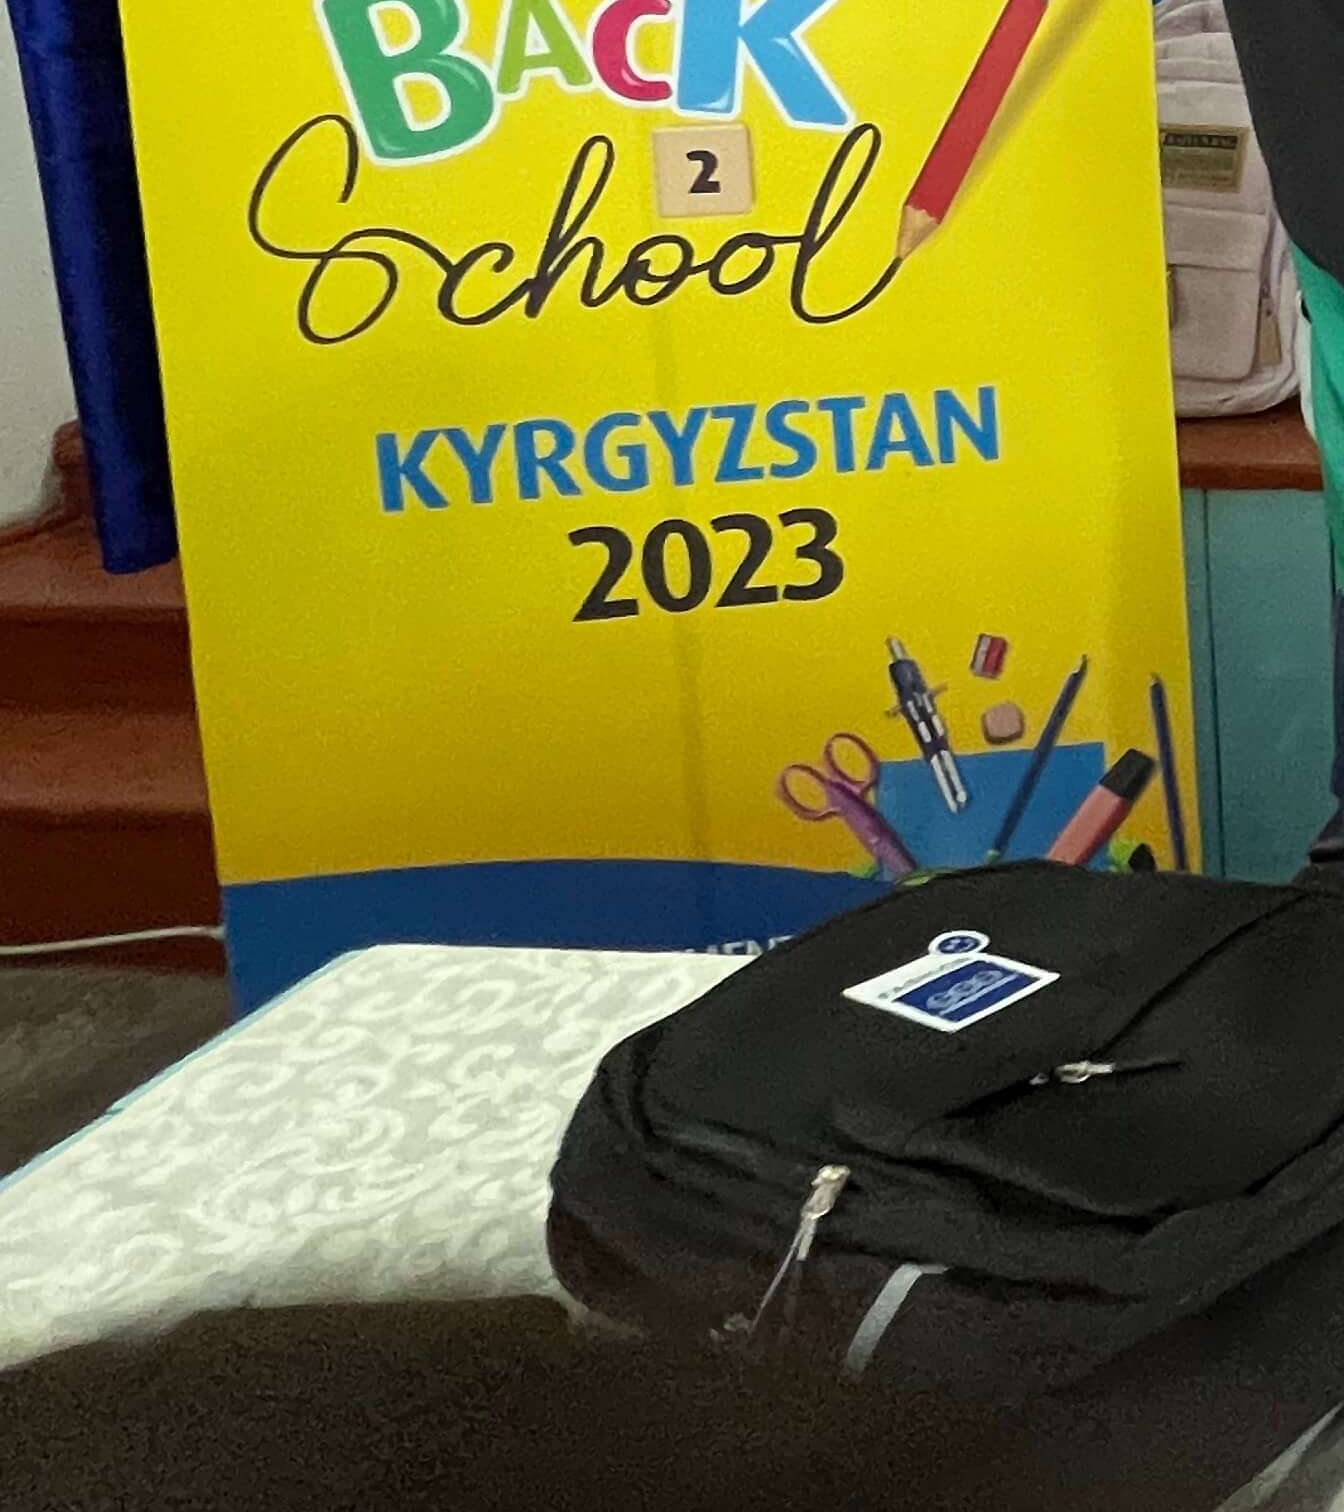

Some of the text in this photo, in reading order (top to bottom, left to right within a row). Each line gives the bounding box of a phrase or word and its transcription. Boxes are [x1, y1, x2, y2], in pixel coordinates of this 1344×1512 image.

[248, 117, 903, 345] School
[687, 150, 722, 195] 2
[375, 385, 1001, 514] KYRGYZSTAN
[567, 507, 847, 624] 2023
